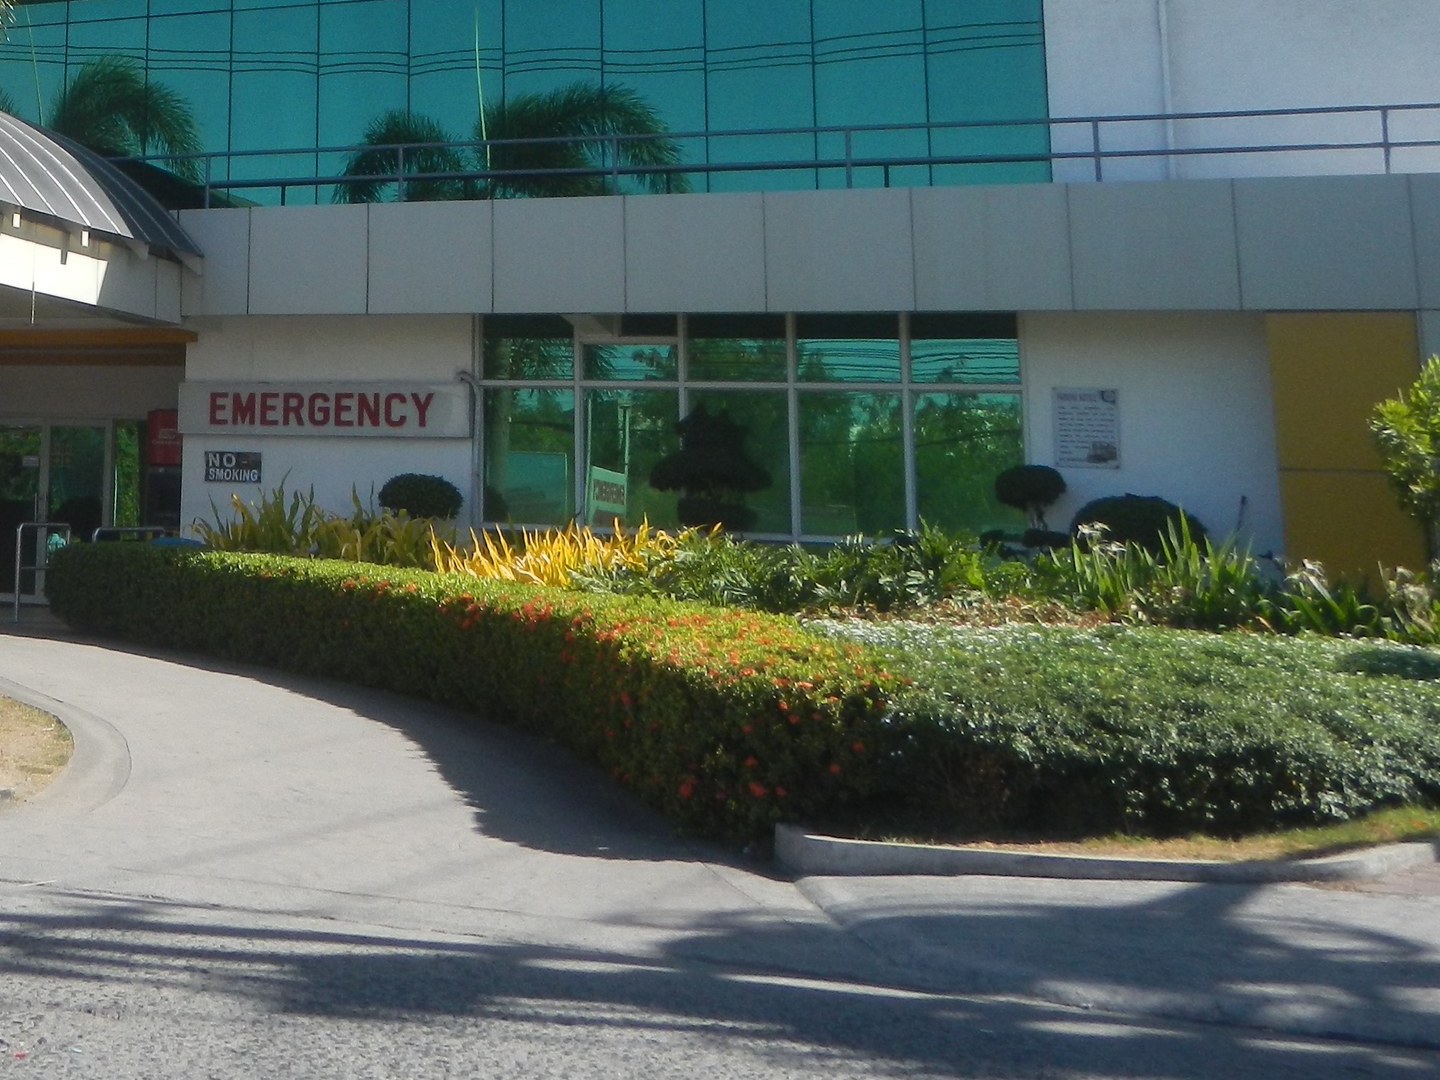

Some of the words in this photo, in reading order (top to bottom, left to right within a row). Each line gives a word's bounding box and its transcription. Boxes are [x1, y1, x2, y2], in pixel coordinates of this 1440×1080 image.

[209, 391, 435, 428] EMERGENCY
[208, 453, 236, 468] NO
[208, 469, 258, 481] SMOKING
